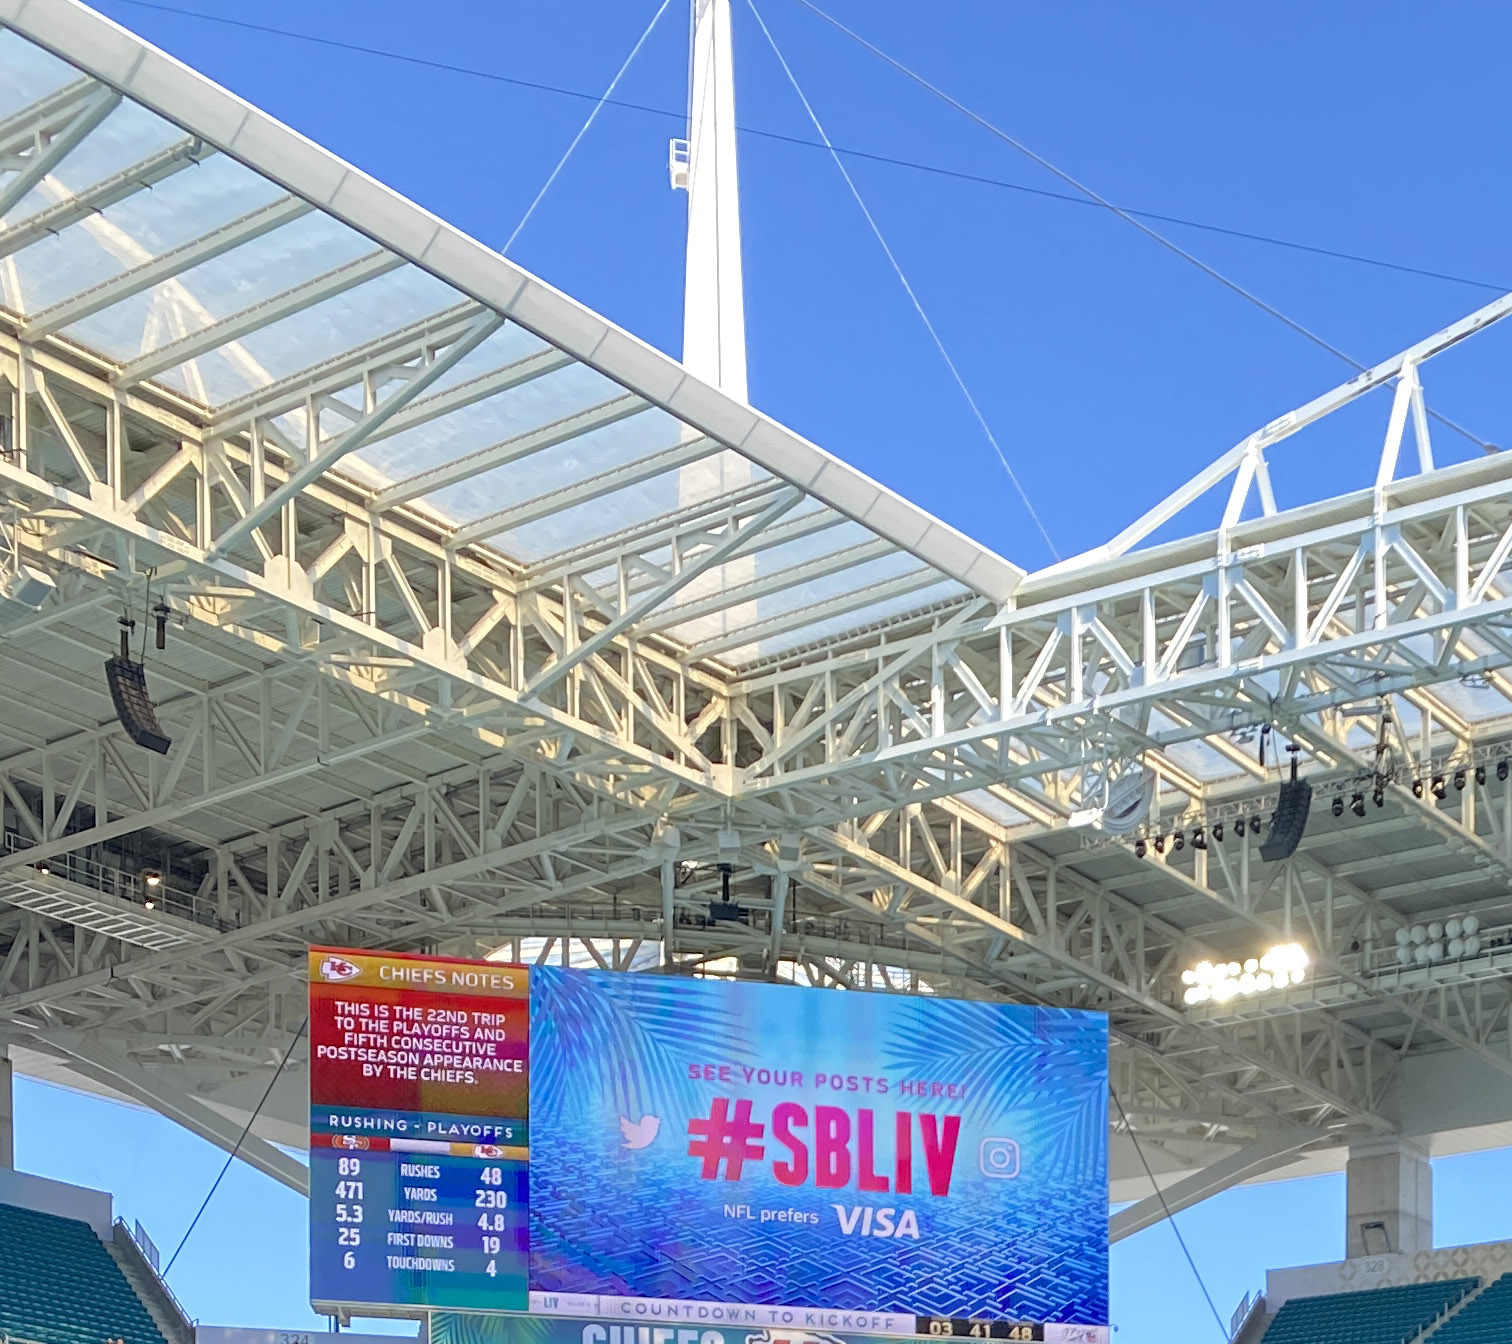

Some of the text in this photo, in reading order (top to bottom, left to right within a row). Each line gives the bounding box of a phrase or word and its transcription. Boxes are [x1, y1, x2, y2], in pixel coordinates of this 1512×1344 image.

[379, 965, 515, 990] CHIEFS NOTES
[335, 1001, 506, 1026] THIS IS THE 22ND TRIP
[334, 1016, 506, 1042] TO THE PLAYOFFS AND
[344, 1031, 497, 1056] FIFTH CONSECUTIVE
[317, 1045, 523, 1073] POSTSEASON APPEARANCE
[363, 1063, 479, 1085] BY THE CHIEFS.
[687, 1063, 969, 1101] SEE YOUR POSTS HERE!
[329, 1114, 408, 1131] RUSHING
[427, 1121, 513, 1139] PLAYOFFS
[687, 1097, 962, 1198] #SBLIV
[338, 1157, 502, 1185] 89 RUSHES 48
[335, 1180, 507, 1209] 471 YARDS 230
[335, 1204, 505, 1232] 5.3 YARDS/RUSH 4.8
[723, 1203, 921, 1239] NFL prefers VISA
[338, 1227, 501, 1254] 25 FIRST DOWNS 19
[343, 1251, 498, 1278] 6 TOUCHDOWNS 4
[1363, 1258, 1385, 1274] 328
[620, 1301, 895, 1330] COUNTDOWN TO KICKOFF
[929, 1321, 1033, 1341] 03 41 48
